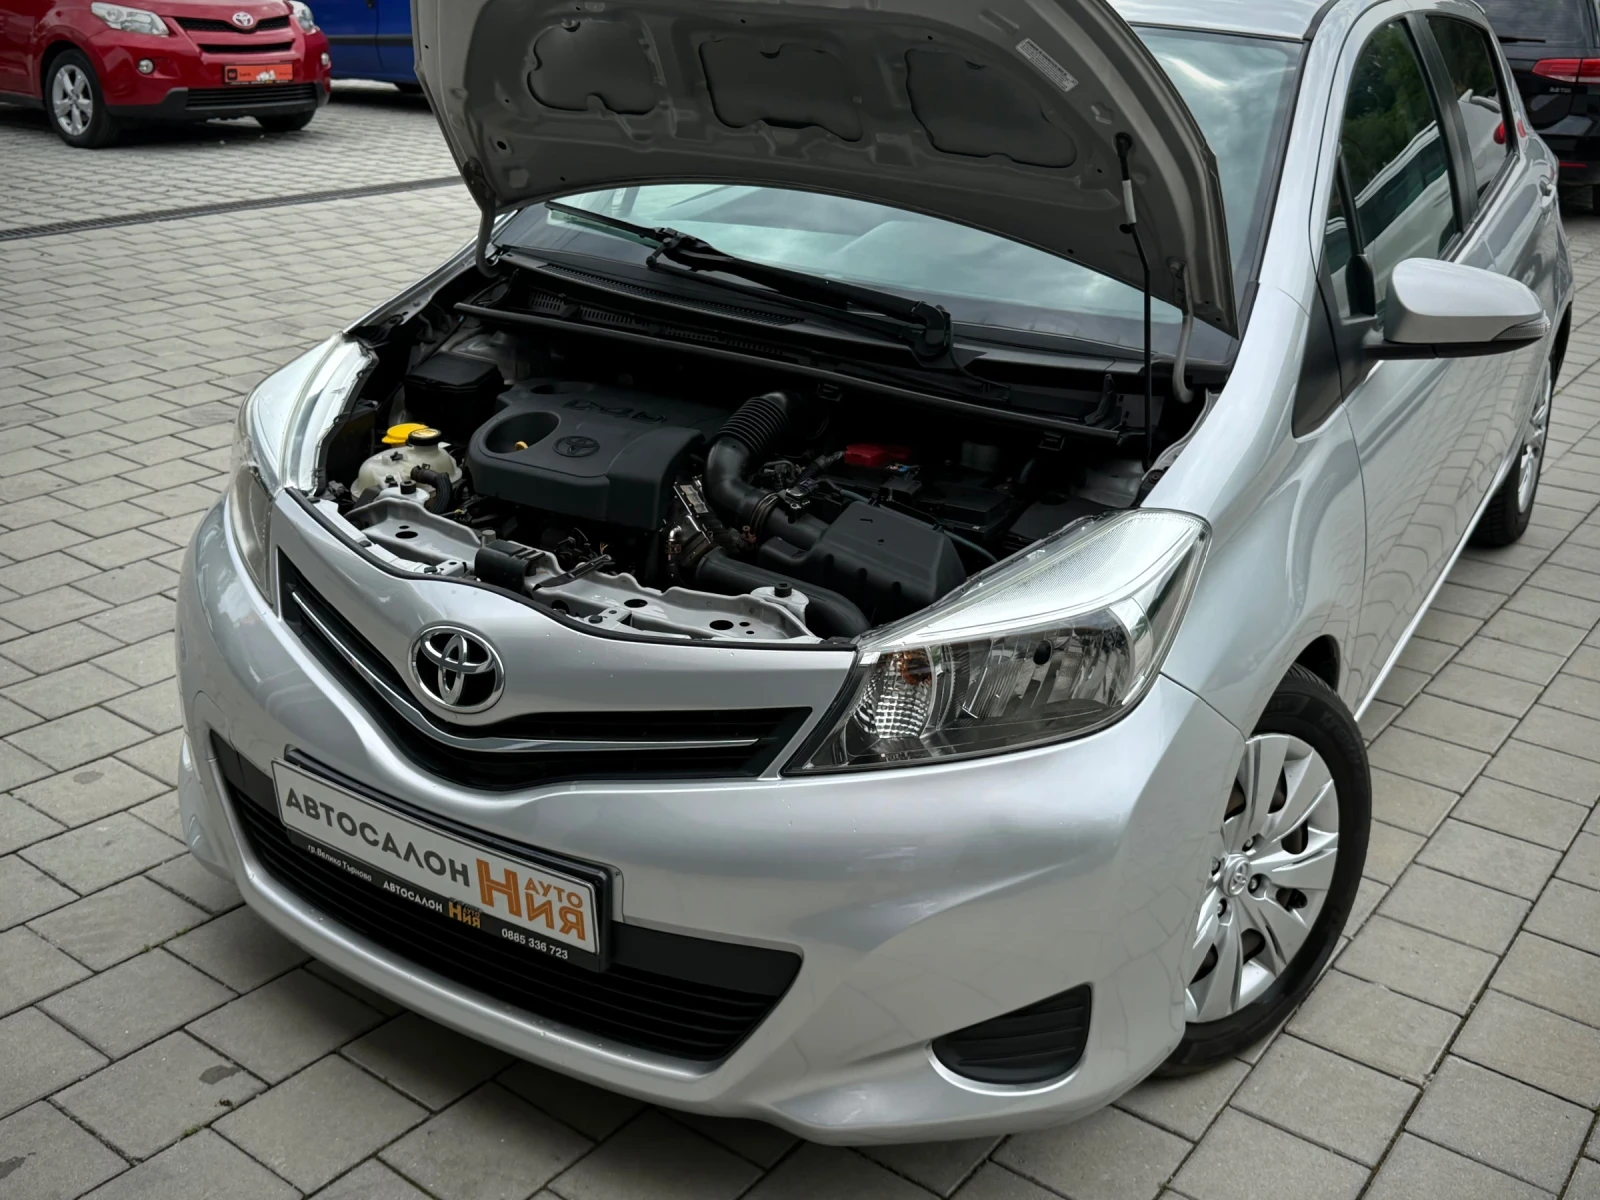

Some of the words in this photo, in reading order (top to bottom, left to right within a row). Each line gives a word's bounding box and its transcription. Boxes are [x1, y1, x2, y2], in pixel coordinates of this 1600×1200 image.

[286, 787, 471, 888] АВТОСАЛОН
[383, 880, 443, 913] АВТОСАЛОН
[524, 877, 584, 909] АУТО
[501, 927, 526, 946] 0885
[528, 935, 548, 953] 336
[549, 942, 569, 960] 723
